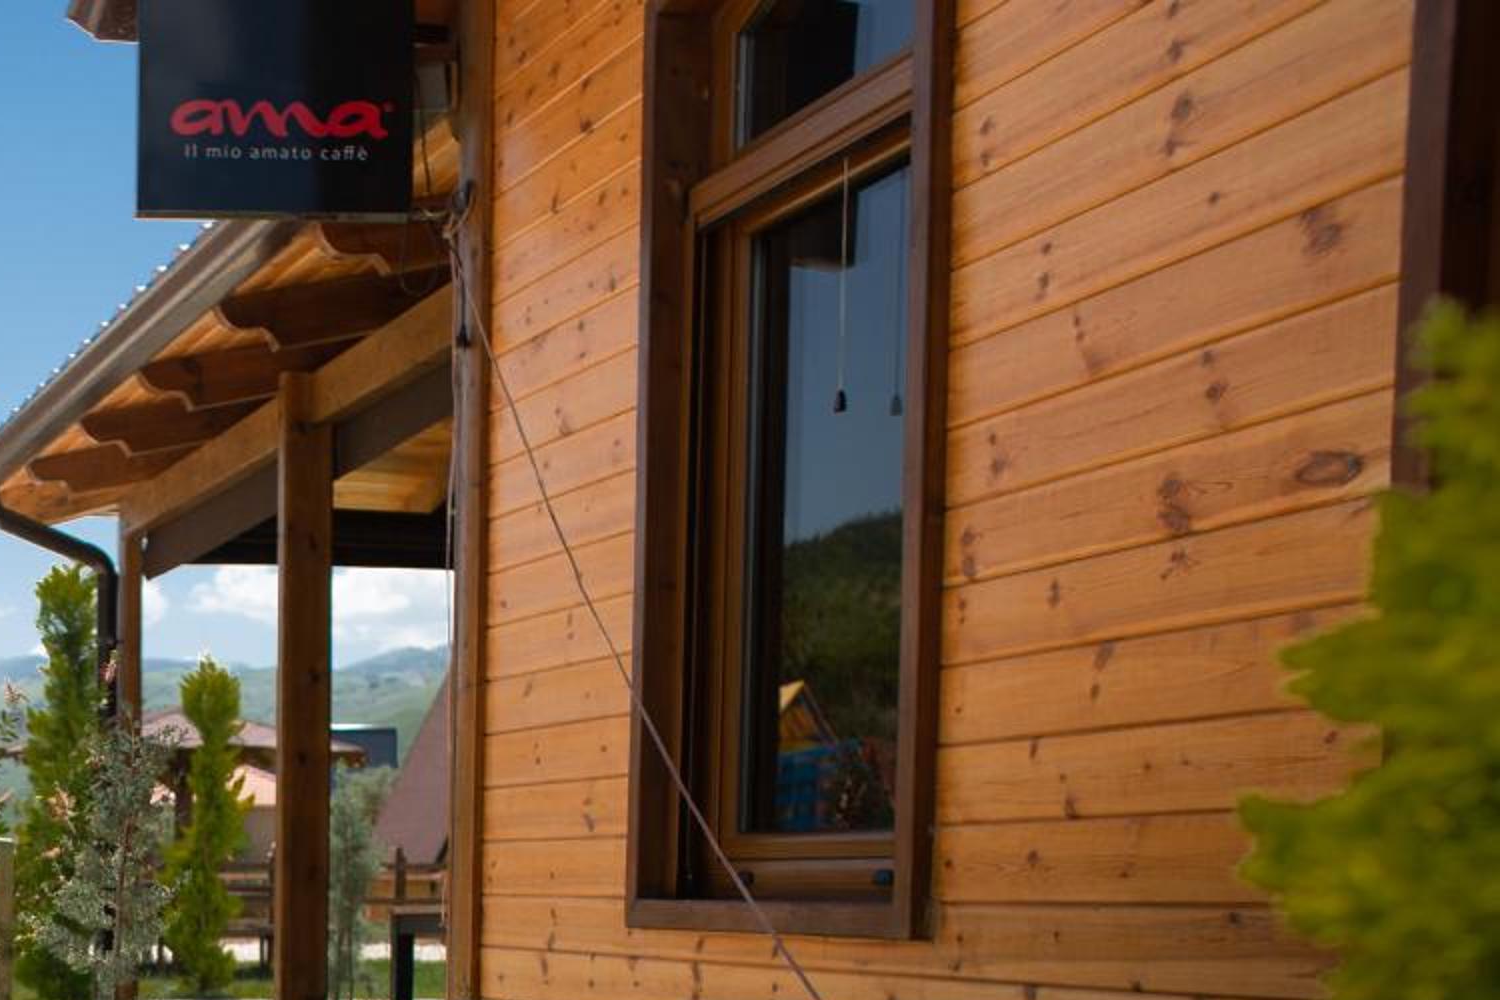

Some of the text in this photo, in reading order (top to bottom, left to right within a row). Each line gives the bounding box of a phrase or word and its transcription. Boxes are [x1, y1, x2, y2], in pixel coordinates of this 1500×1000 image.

[170, 99, 389, 138] ama
[206, 143, 242, 159] mio
[249, 145, 312, 160] amato
